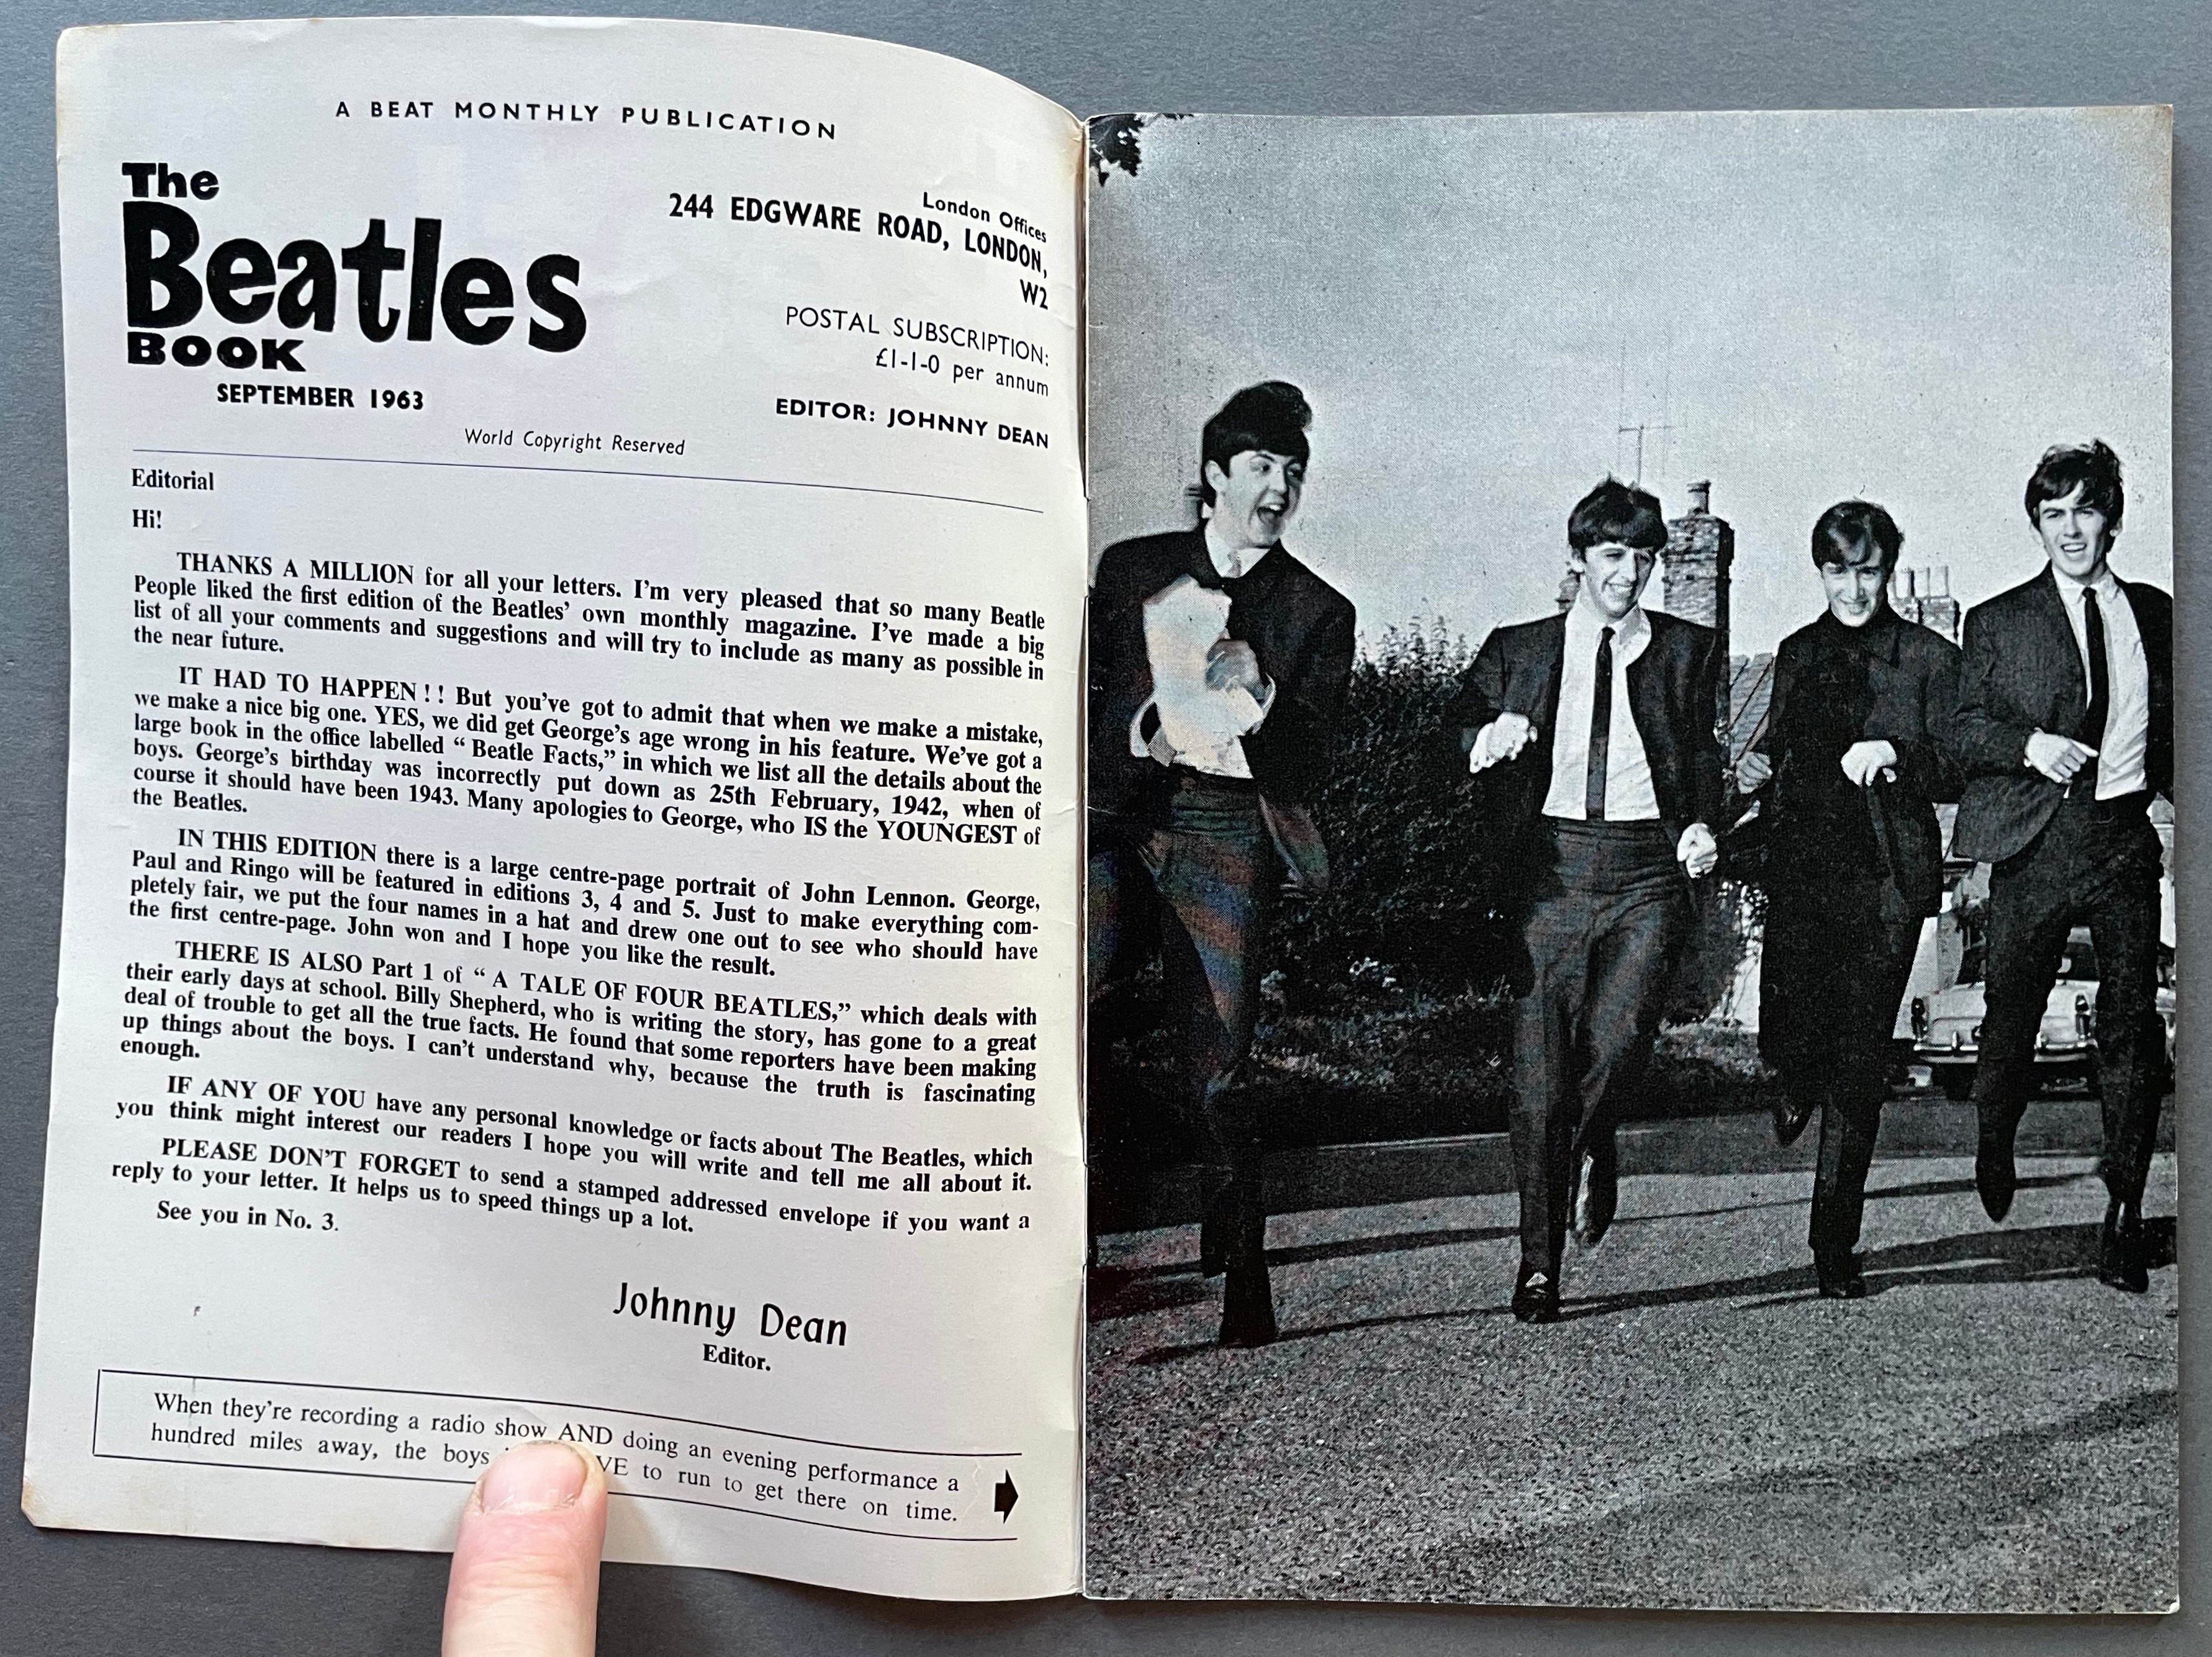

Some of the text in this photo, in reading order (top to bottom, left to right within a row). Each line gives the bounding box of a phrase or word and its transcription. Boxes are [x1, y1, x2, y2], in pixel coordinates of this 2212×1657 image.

[335, 101, 835, 140] A BEAT MONTHLY PUBLICATION
[121, 162, 220, 201] The
[669, 192, 1047, 279] 244 EDGWARE ROAD, LONDON,
[923, 191, 1047, 243] London Offices
[122, 200, 587, 353] Beatles
[1019, 279, 1049, 310] W2
[127, 331, 307, 372] BOOK
[786, 306, 1049, 367] POSTAL SUBSCRIPTION:
[217, 382, 423, 410] SEPTEMBER 1963
[953, 364, 985, 384] per
[996, 372, 1049, 397] annum
[464, 428, 685, 456] World Copyright Reserved
[776, 398, 1048, 449] EDITOR: JOHNNY DEAN
[131, 468, 214, 491] Editorial
[132, 508, 161, 529] Hi!
[176, 551, 1045, 630] THANKS A MILLION for all your letters. I'm very pleased that so many Beatle
[133, 625, 284, 653] the near future.
[133, 787, 248, 813] the Beatles.
[134, 738, 1042, 820] boys. George's birthday was incorrectly put down as 25th February, 1942, when of
[178, 828, 1040, 914] IN THIS EDITION there is a large centre-page portrait of John Lennon. George,
[120, 1039, 200, 1062] enough.
[123, 1013, 1036, 1106] up things about the boys. I can't understand why, because the truth is fascinating
[166, 1075, 1032, 1171] IF ANY OF YOU have any personal knowledge or facts about The Beatles, which
[161, 1137, 1029, 1235] PLEASE DON'T FORGET to send a stamped addressed envelope if you want a
[156, 1200, 192, 1221] See
[200, 1208, 238, 1227] you
[247, 1206, 267, 1226] in
[275, 1208, 312, 1229] No.
[612, 1282, 847, 1347] Johnny Dean
[703, 1343, 771, 1371] Editor.
[151, 1422, 489, 1469] hundred miles away, the boys
[154, 1392, 959, 1491] When they're recording a radio show AND doing an evening performance a
[595, 1455, 957, 1522] VE to run to get there on time.
